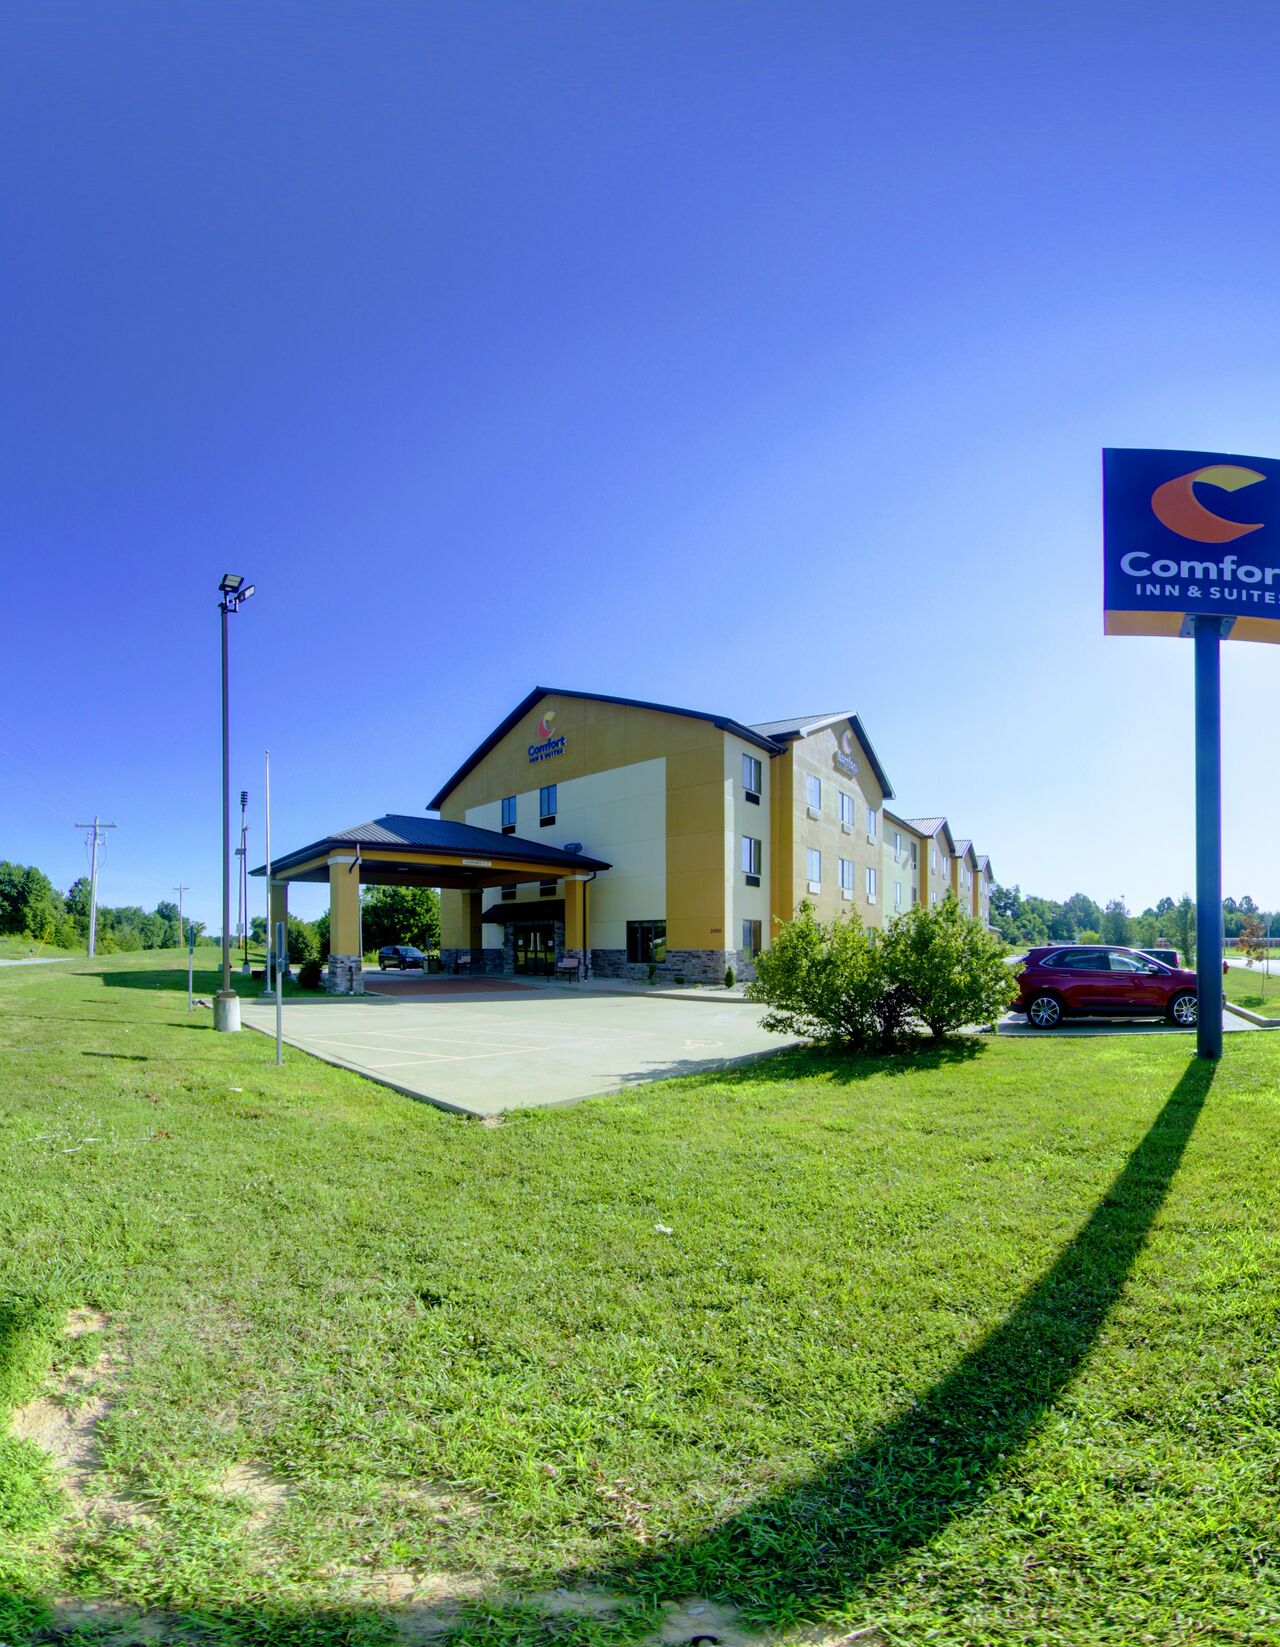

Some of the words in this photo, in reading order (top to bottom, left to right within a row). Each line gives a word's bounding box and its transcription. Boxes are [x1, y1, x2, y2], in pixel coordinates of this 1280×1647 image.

[1136, 583, 1180, 597] INN
[1187, 585, 1202, 598] &
[528, 736, 566, 756] Comfort
